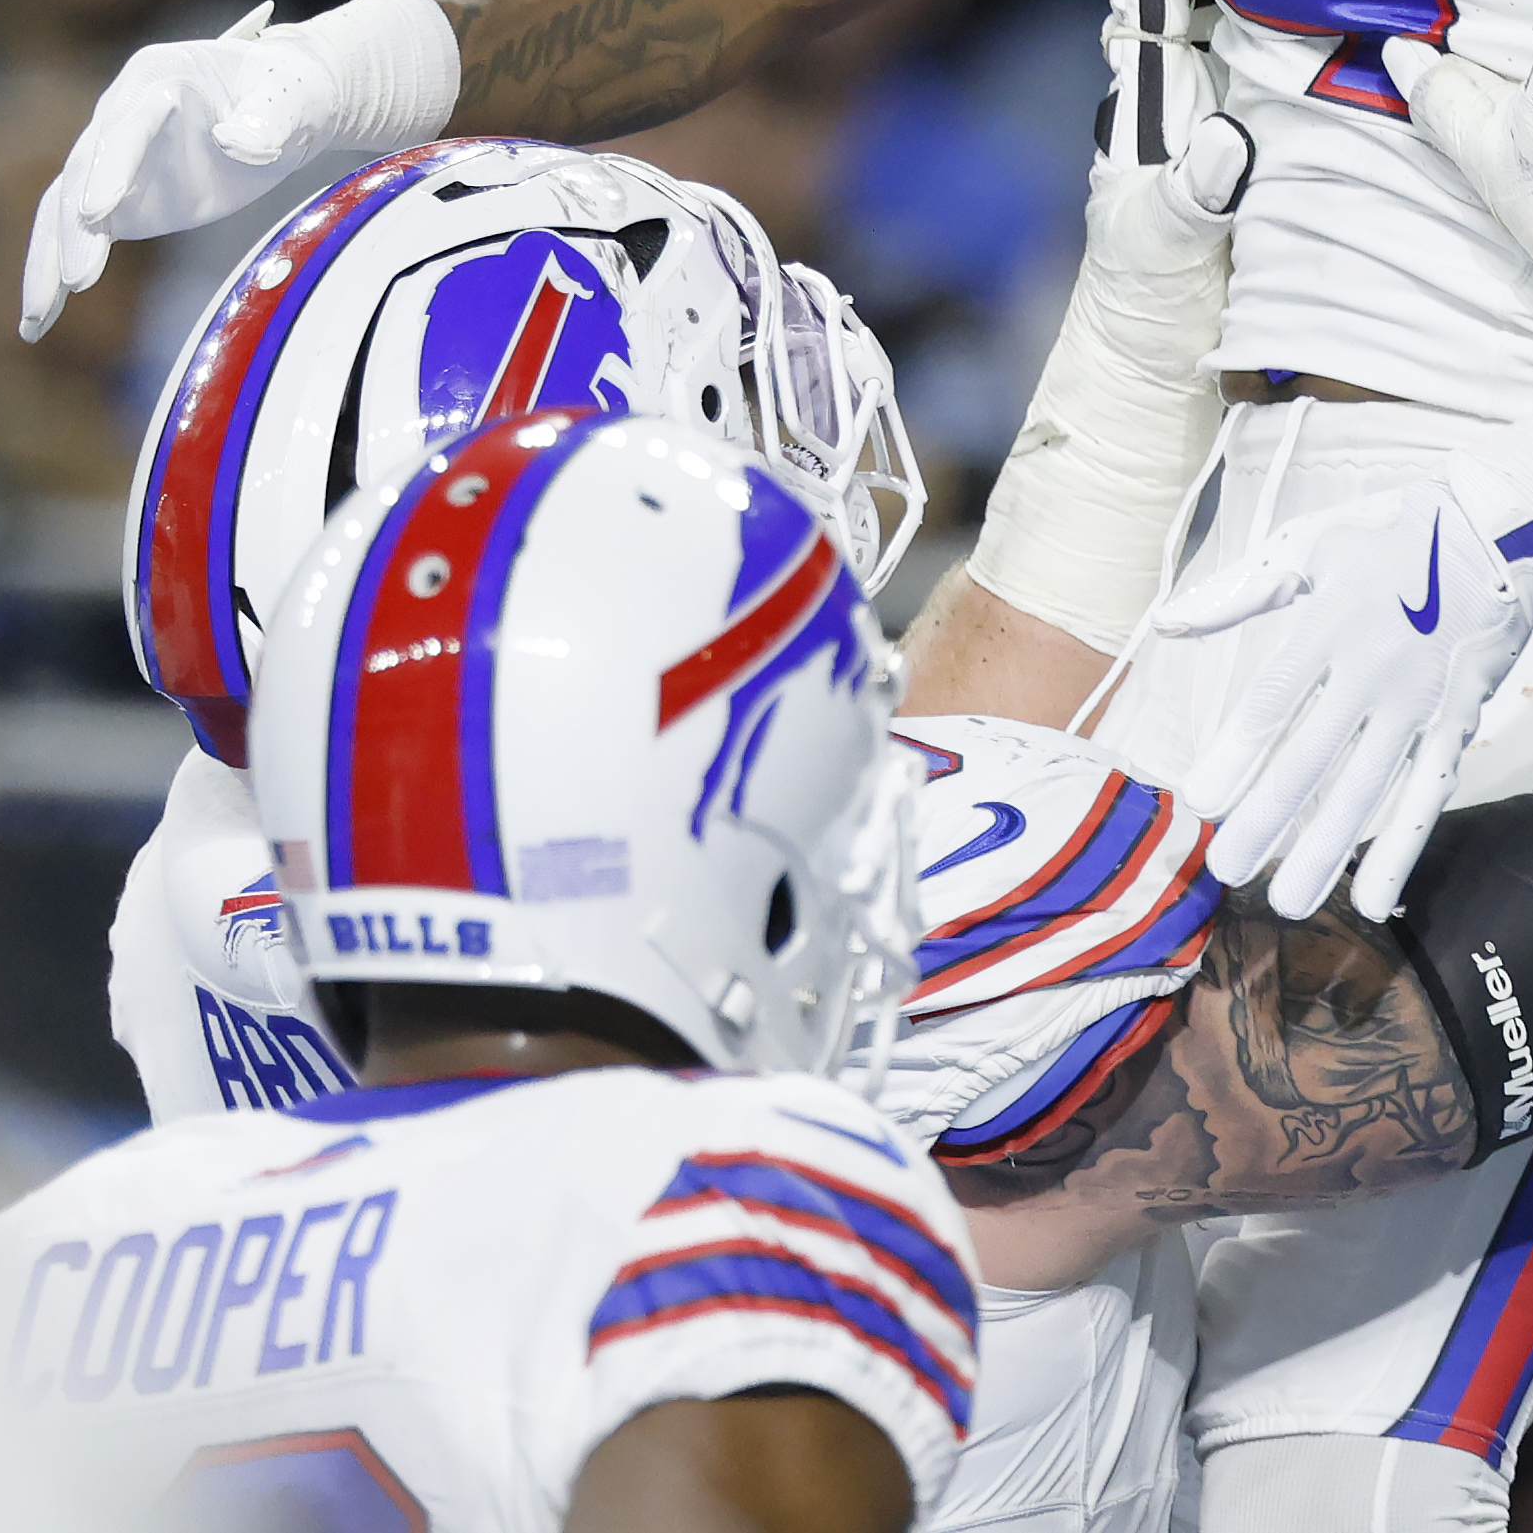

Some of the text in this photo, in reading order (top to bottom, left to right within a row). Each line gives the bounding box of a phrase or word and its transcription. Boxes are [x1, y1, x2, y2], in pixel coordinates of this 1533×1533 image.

[326, 912, 492, 957] BILLS
[1471, 945, 1533, 1128] Mueller
[9, 1189, 398, 1406] COOPER
